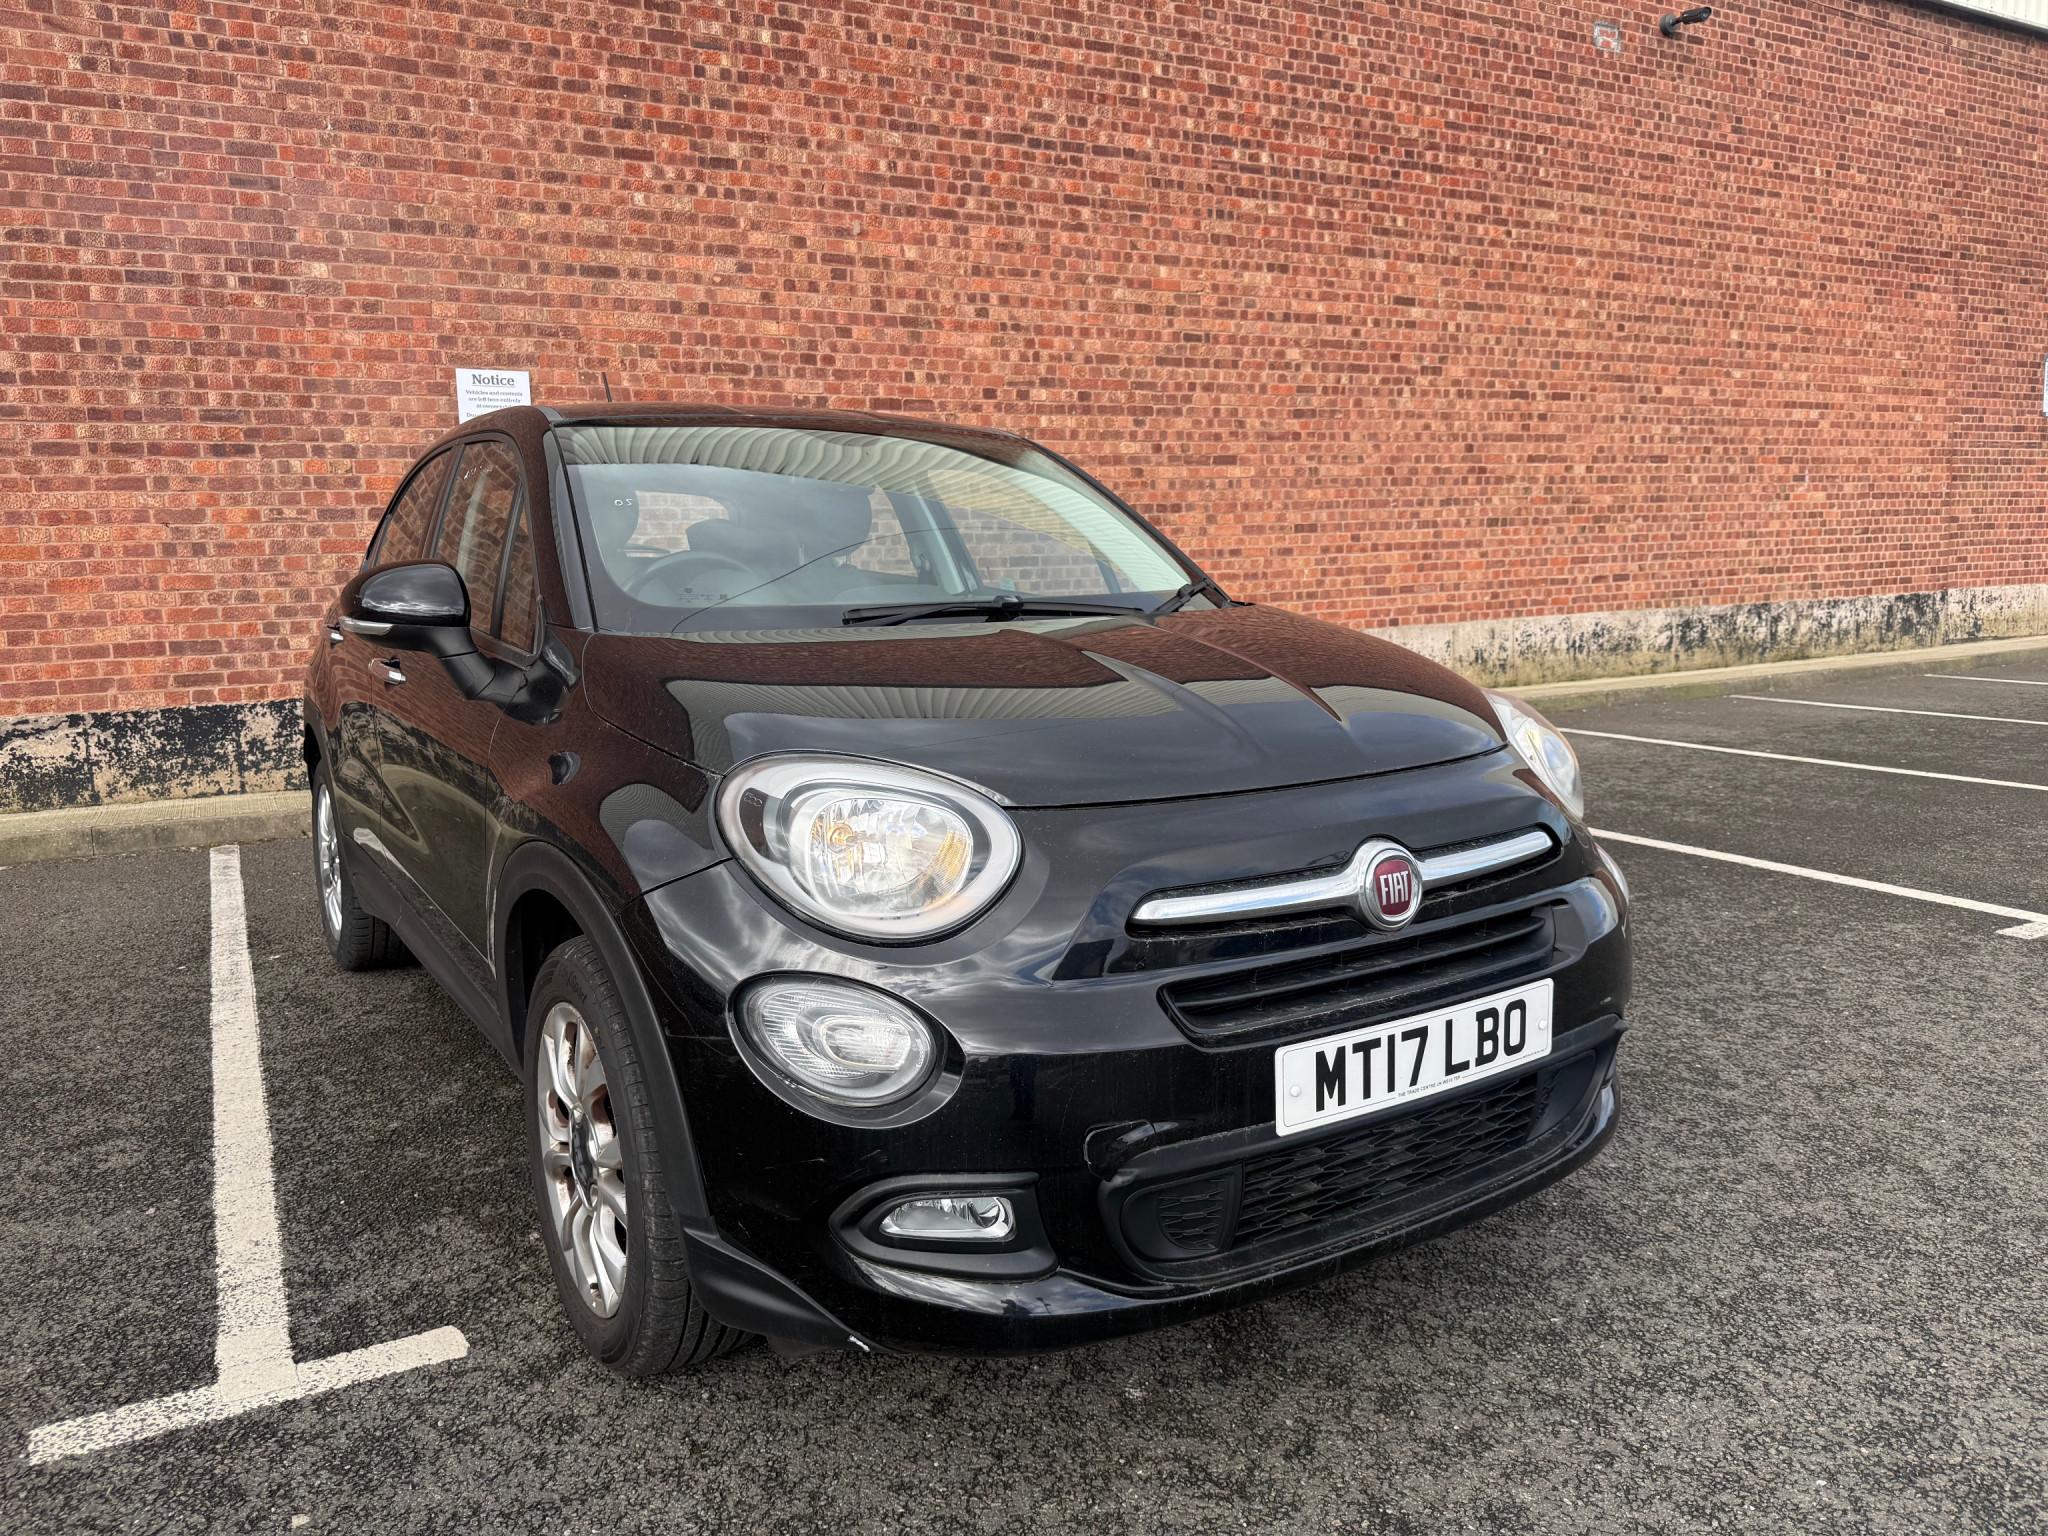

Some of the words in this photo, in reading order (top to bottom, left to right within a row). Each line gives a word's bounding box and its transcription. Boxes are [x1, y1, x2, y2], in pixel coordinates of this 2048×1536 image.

[471, 373, 515, 386] Notice
[1379, 870, 1409, 906] FIAT
[1315, 1024, 1429, 1113] MT17
[1444, 998, 1527, 1078] LBO
[1420, 1082, 1436, 1091] CENTRE
